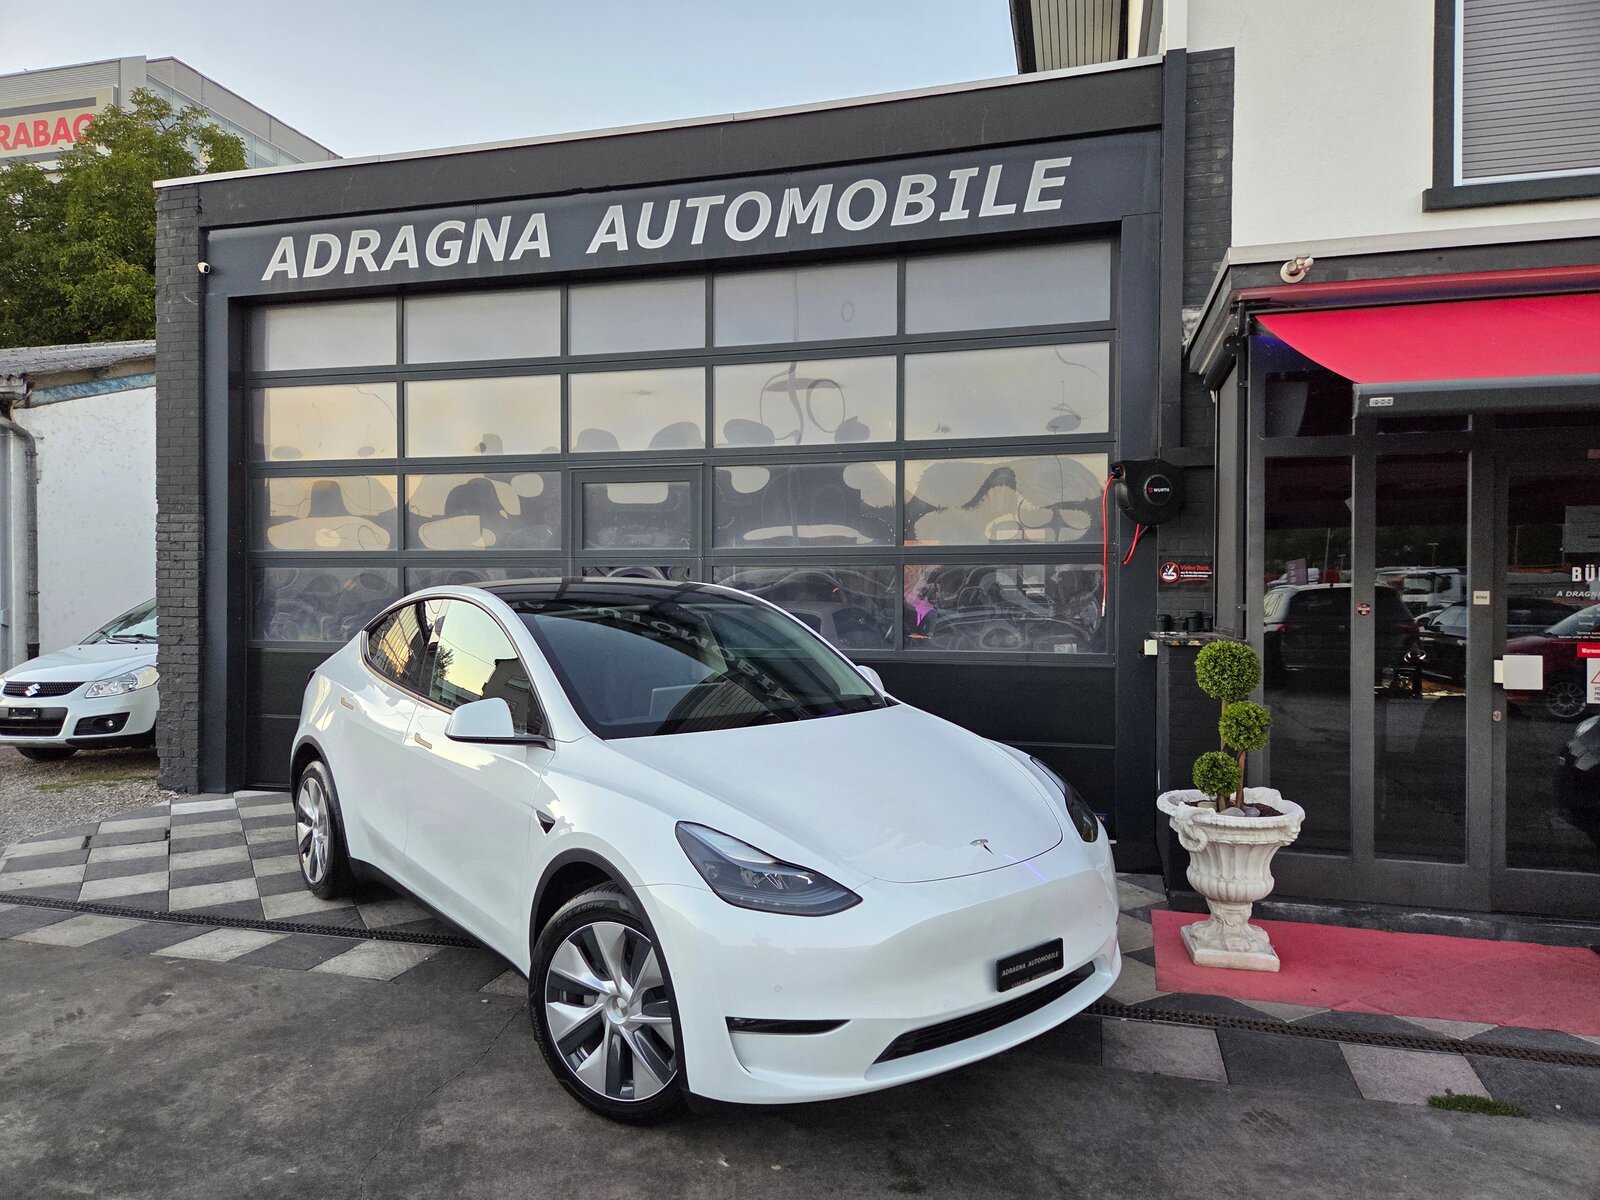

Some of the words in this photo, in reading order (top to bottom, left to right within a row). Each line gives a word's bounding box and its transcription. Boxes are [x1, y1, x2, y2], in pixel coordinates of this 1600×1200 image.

[261, 213, 551, 281] ADRAGNA
[585, 157, 1072, 254] AUTOMOBILE
[1571, 564, 1600, 582] BÜ
[1002, 963, 1026, 976] ADRAGNA
[1028, 951, 1059, 967] AUTOMOBILE
